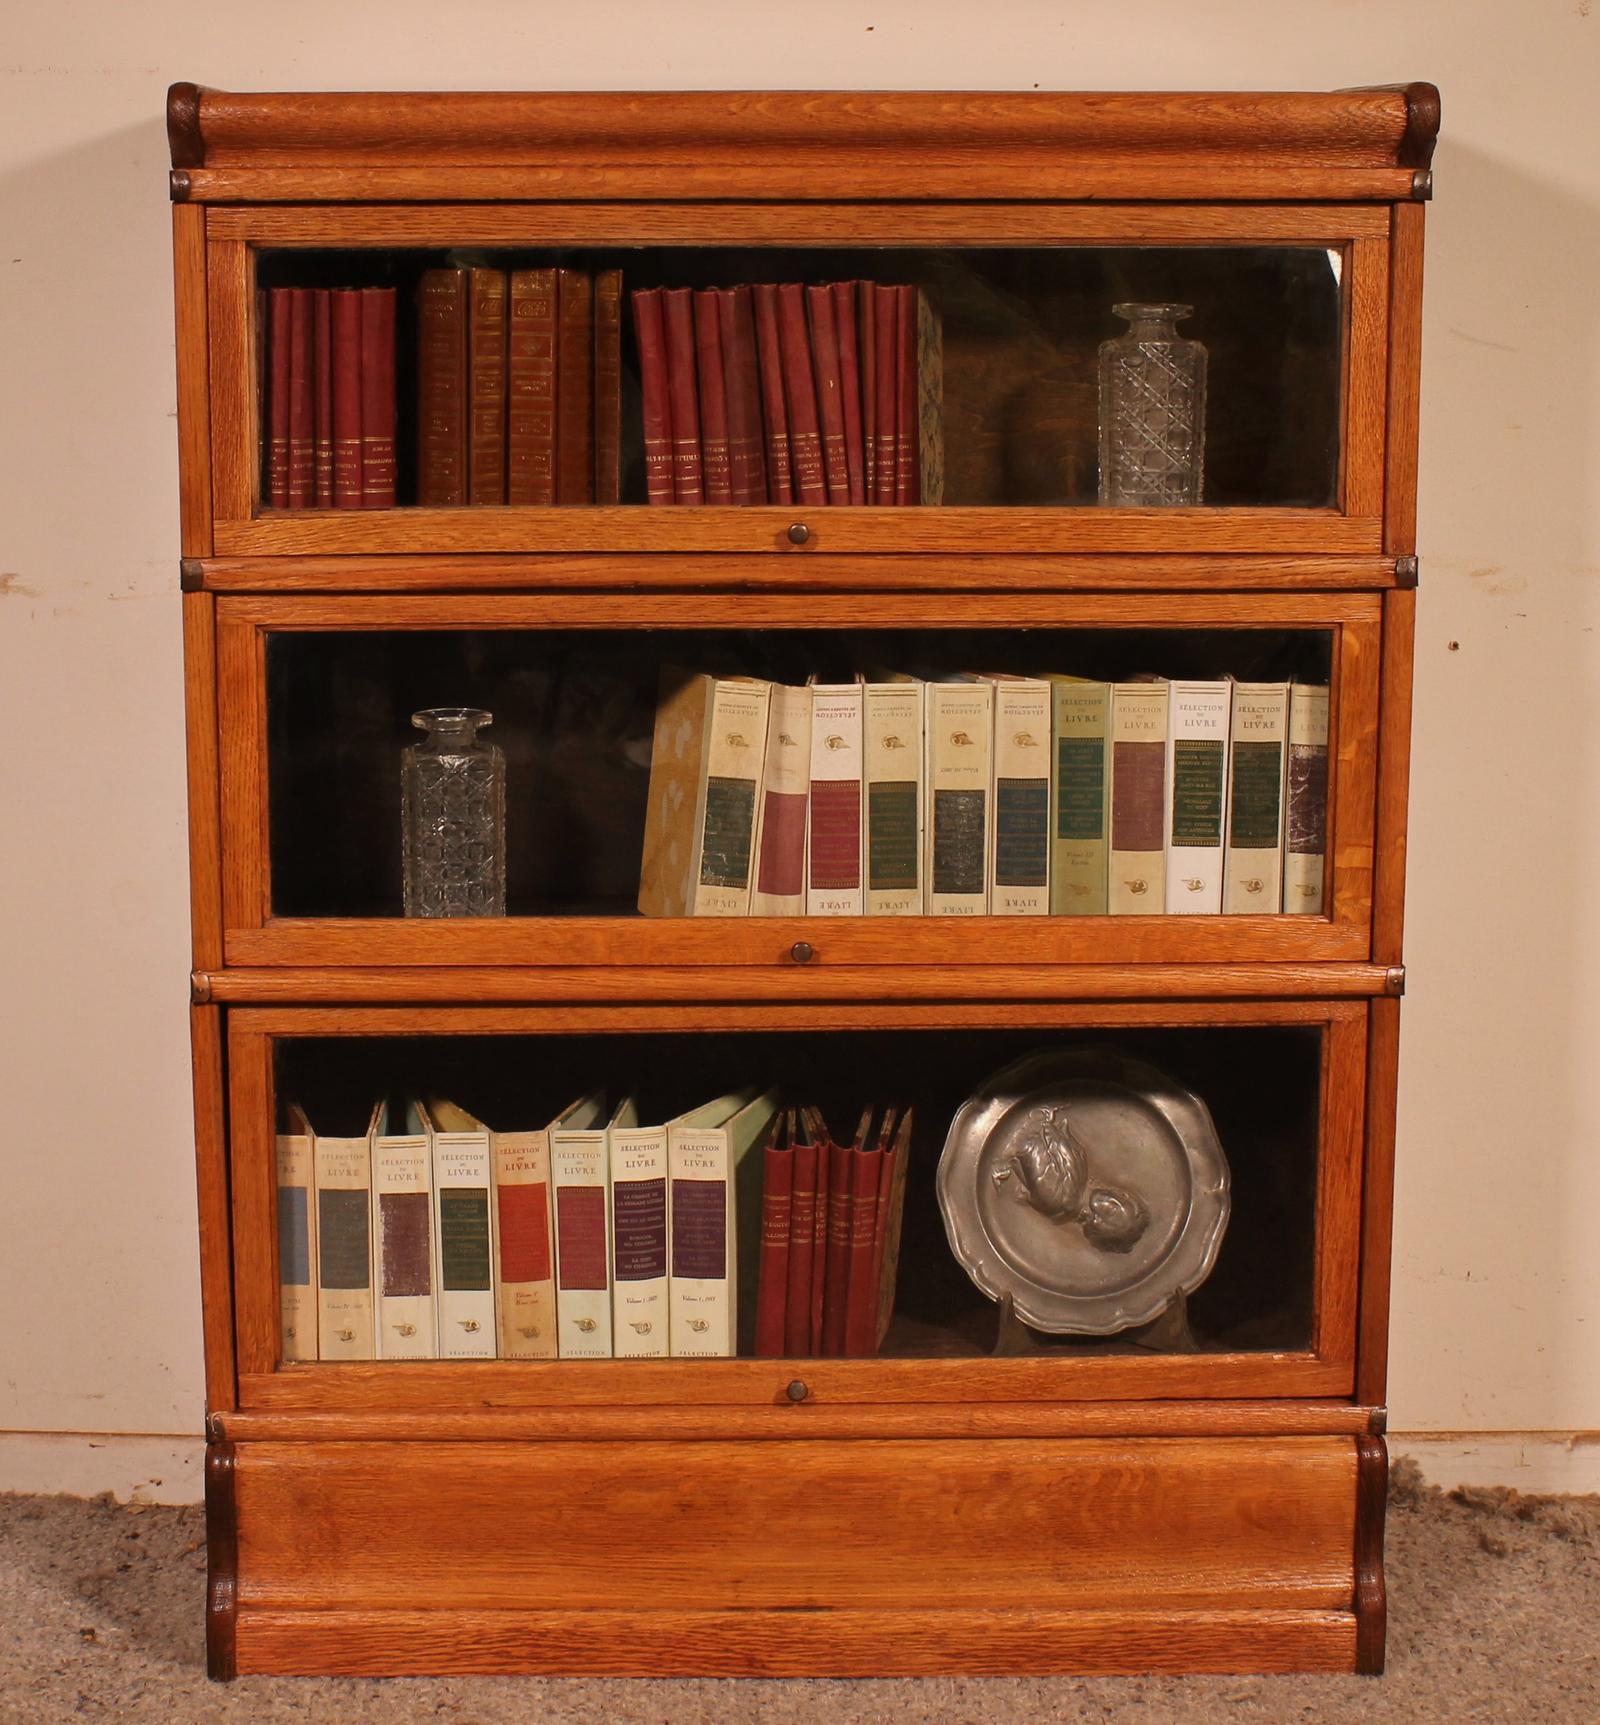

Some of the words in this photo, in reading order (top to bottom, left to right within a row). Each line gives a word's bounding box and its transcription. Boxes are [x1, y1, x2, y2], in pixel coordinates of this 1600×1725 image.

[1243, 721, 1275, 729] LIVRE
[819, 901, 851, 909] LIVRE
[1005, 898, 1037, 907] LIVRE
[941, 906, 973, 914] LIVRE
[505, 1162, 536, 1171] LIVRE
[626, 1159, 656, 1168] LIVRE
[564, 1167, 596, 1175] LIVRE
